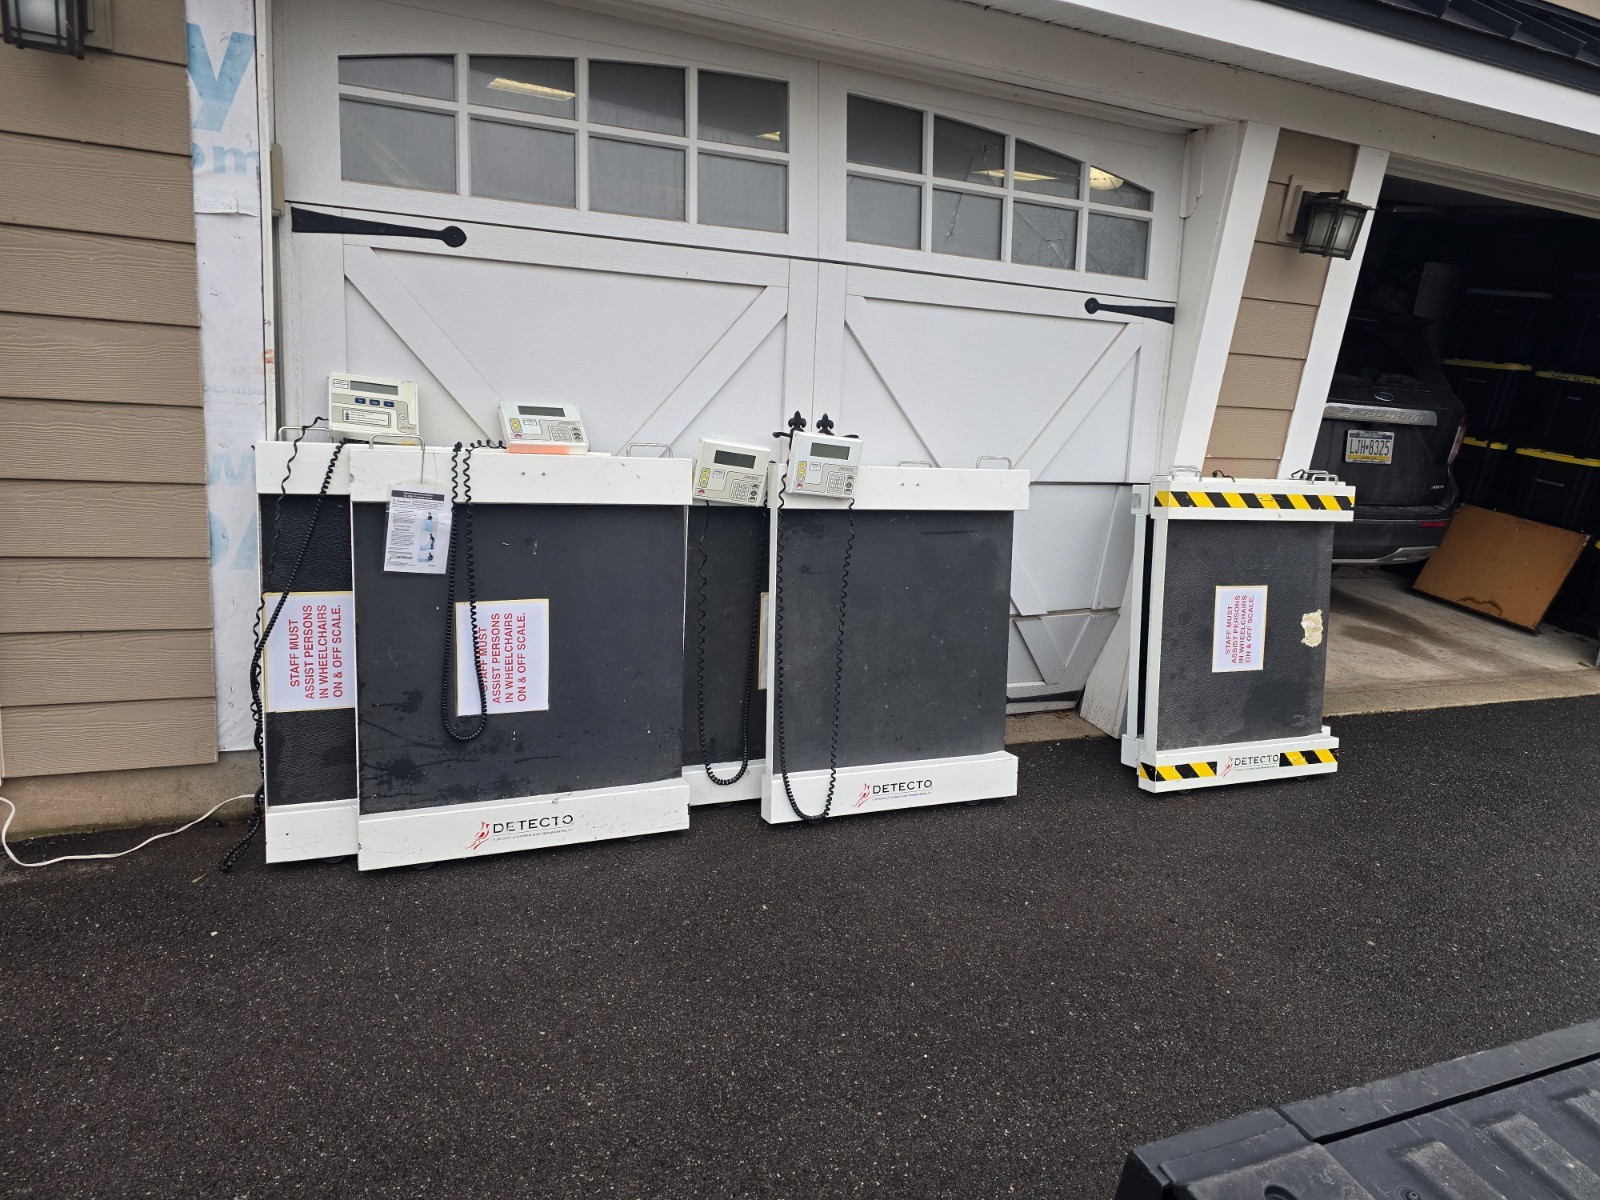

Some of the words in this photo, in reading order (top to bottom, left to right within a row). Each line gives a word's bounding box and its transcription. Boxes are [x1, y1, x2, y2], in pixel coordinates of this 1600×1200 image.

[288, 619, 299, 650] MUST
[302, 605, 314, 658] PERSONS
[331, 604, 342, 644] SCALE.
[491, 613, 501, 664] PERSONS
[516, 612, 526, 650] SCALE.
[1239, 595, 1248, 654] WHEELCHAIRS
[317, 604, 328, 685] WHEELCHAIRS
[478, 627, 488, 656] MUST
[504, 612, 514, 690] WHEELCHAIRS
[1231, 635, 1239, 664] ASSIST
[289, 653, 300, 687] STAFF
[332, 646, 343, 668] OFF
[517, 653, 526, 673] OFF
[1238, 655, 1244, 664] IN
[1245, 651, 1251, 663] ON
[304, 661, 315, 699] ASSIST
[319, 689, 329, 699] IN
[333, 681, 343, 698] ON
[491, 667, 501, 703] ASSIST
[517, 686, 527, 702] ON
[504, 692, 514, 703] IN
[1234, 754, 1280, 766] DETECTO
[872, 779, 933, 795] DETECTO
[493, 814, 574, 834] DETECTO
